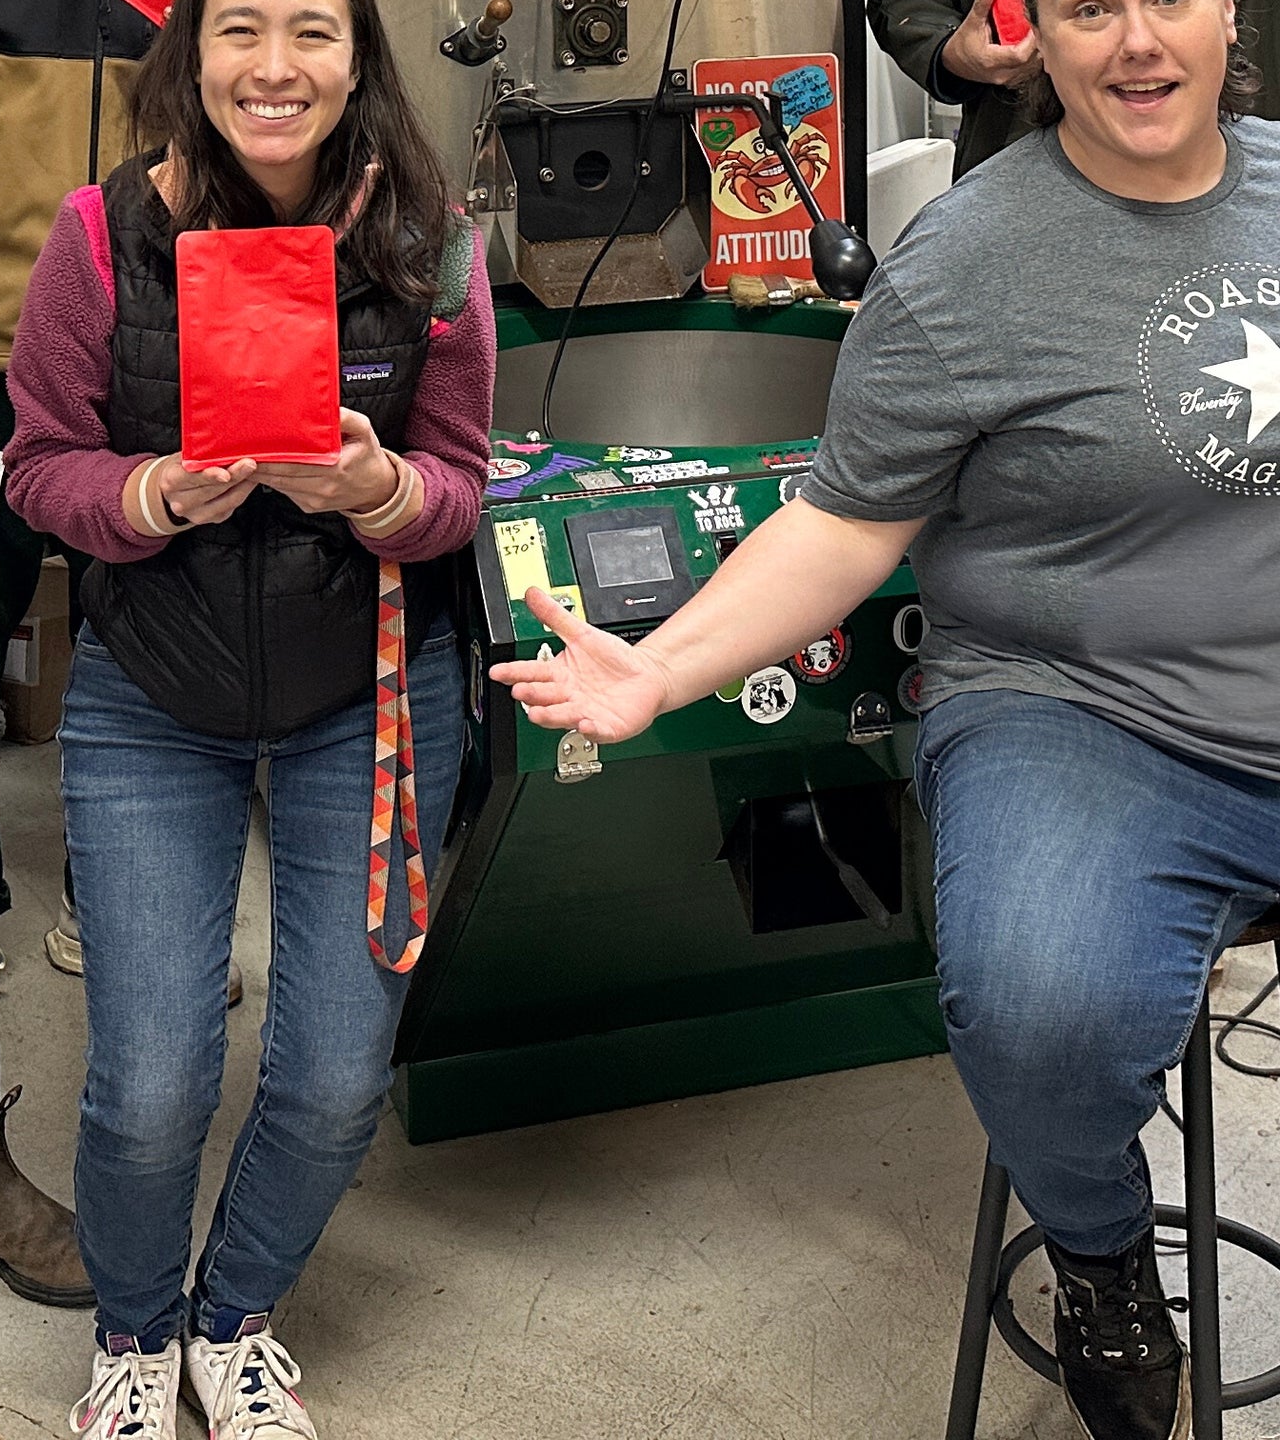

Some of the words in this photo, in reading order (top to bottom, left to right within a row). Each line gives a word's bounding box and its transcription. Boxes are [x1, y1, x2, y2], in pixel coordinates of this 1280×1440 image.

[776, 70, 807, 91] Please
[705, 81, 735, 113] NO
[346, 371, 390, 382] patagonia
[1178, 385, 1244, 420] Twenty
[696, 516, 713, 532] TO
[713, 513, 745, 530] ROCK
